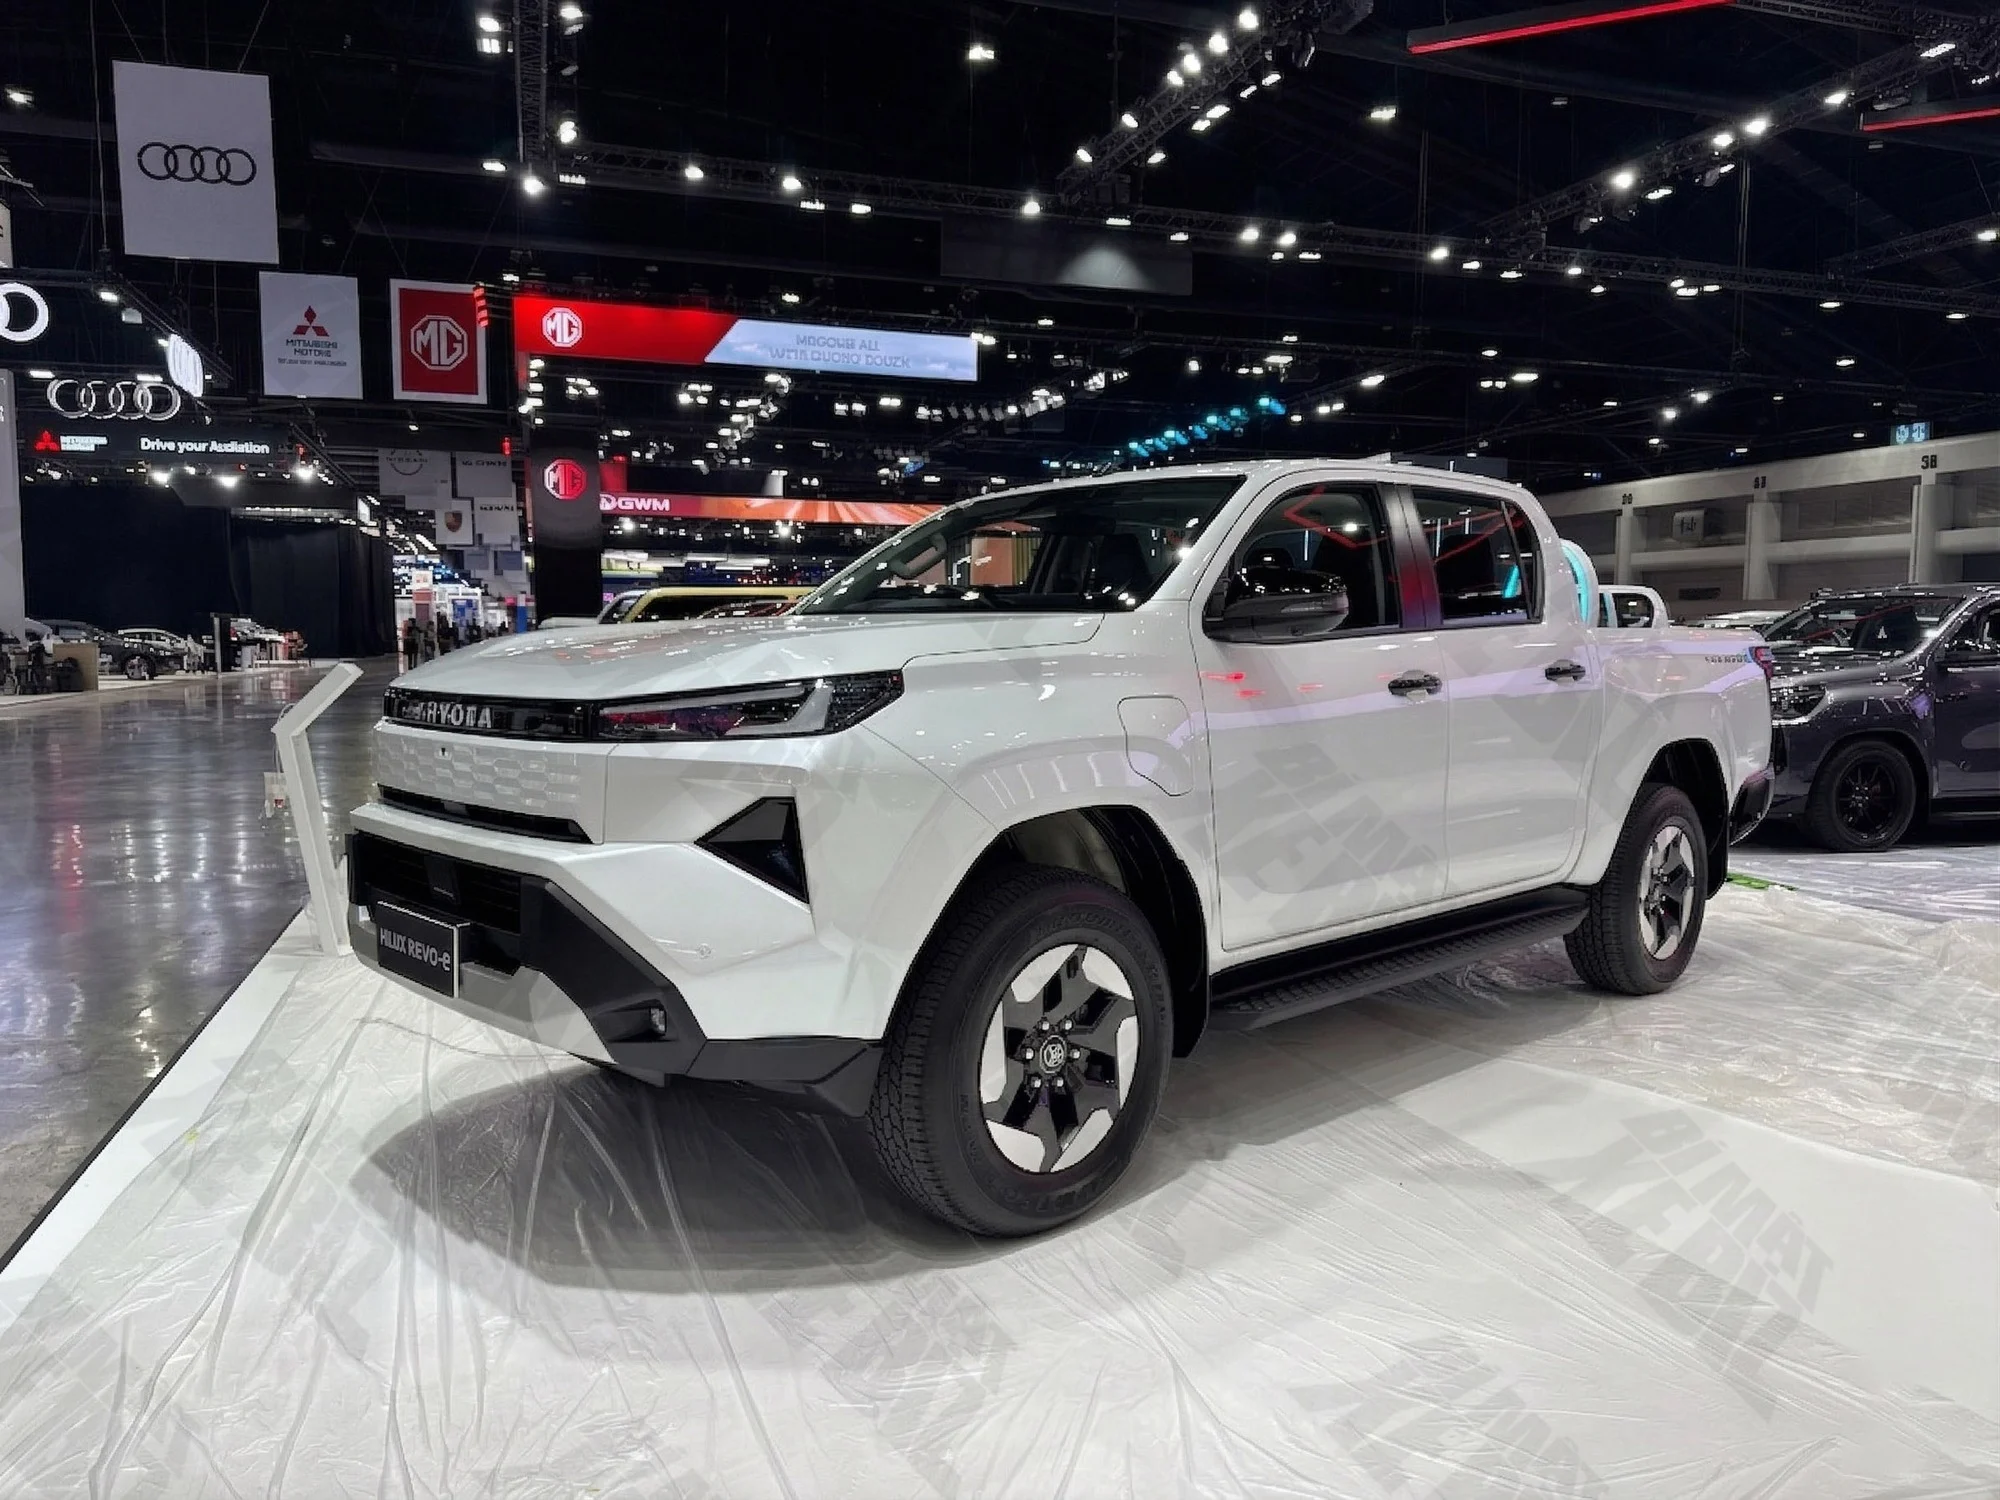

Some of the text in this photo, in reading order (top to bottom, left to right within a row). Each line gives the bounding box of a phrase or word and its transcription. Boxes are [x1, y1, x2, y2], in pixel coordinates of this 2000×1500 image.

[414, 318, 465, 368] MG
[545, 310, 581, 345] MG
[140, 437, 175, 451] Drive
[177, 441, 208, 454] your
[546, 461, 585, 498] MG
[617, 498, 671, 512] GWM
